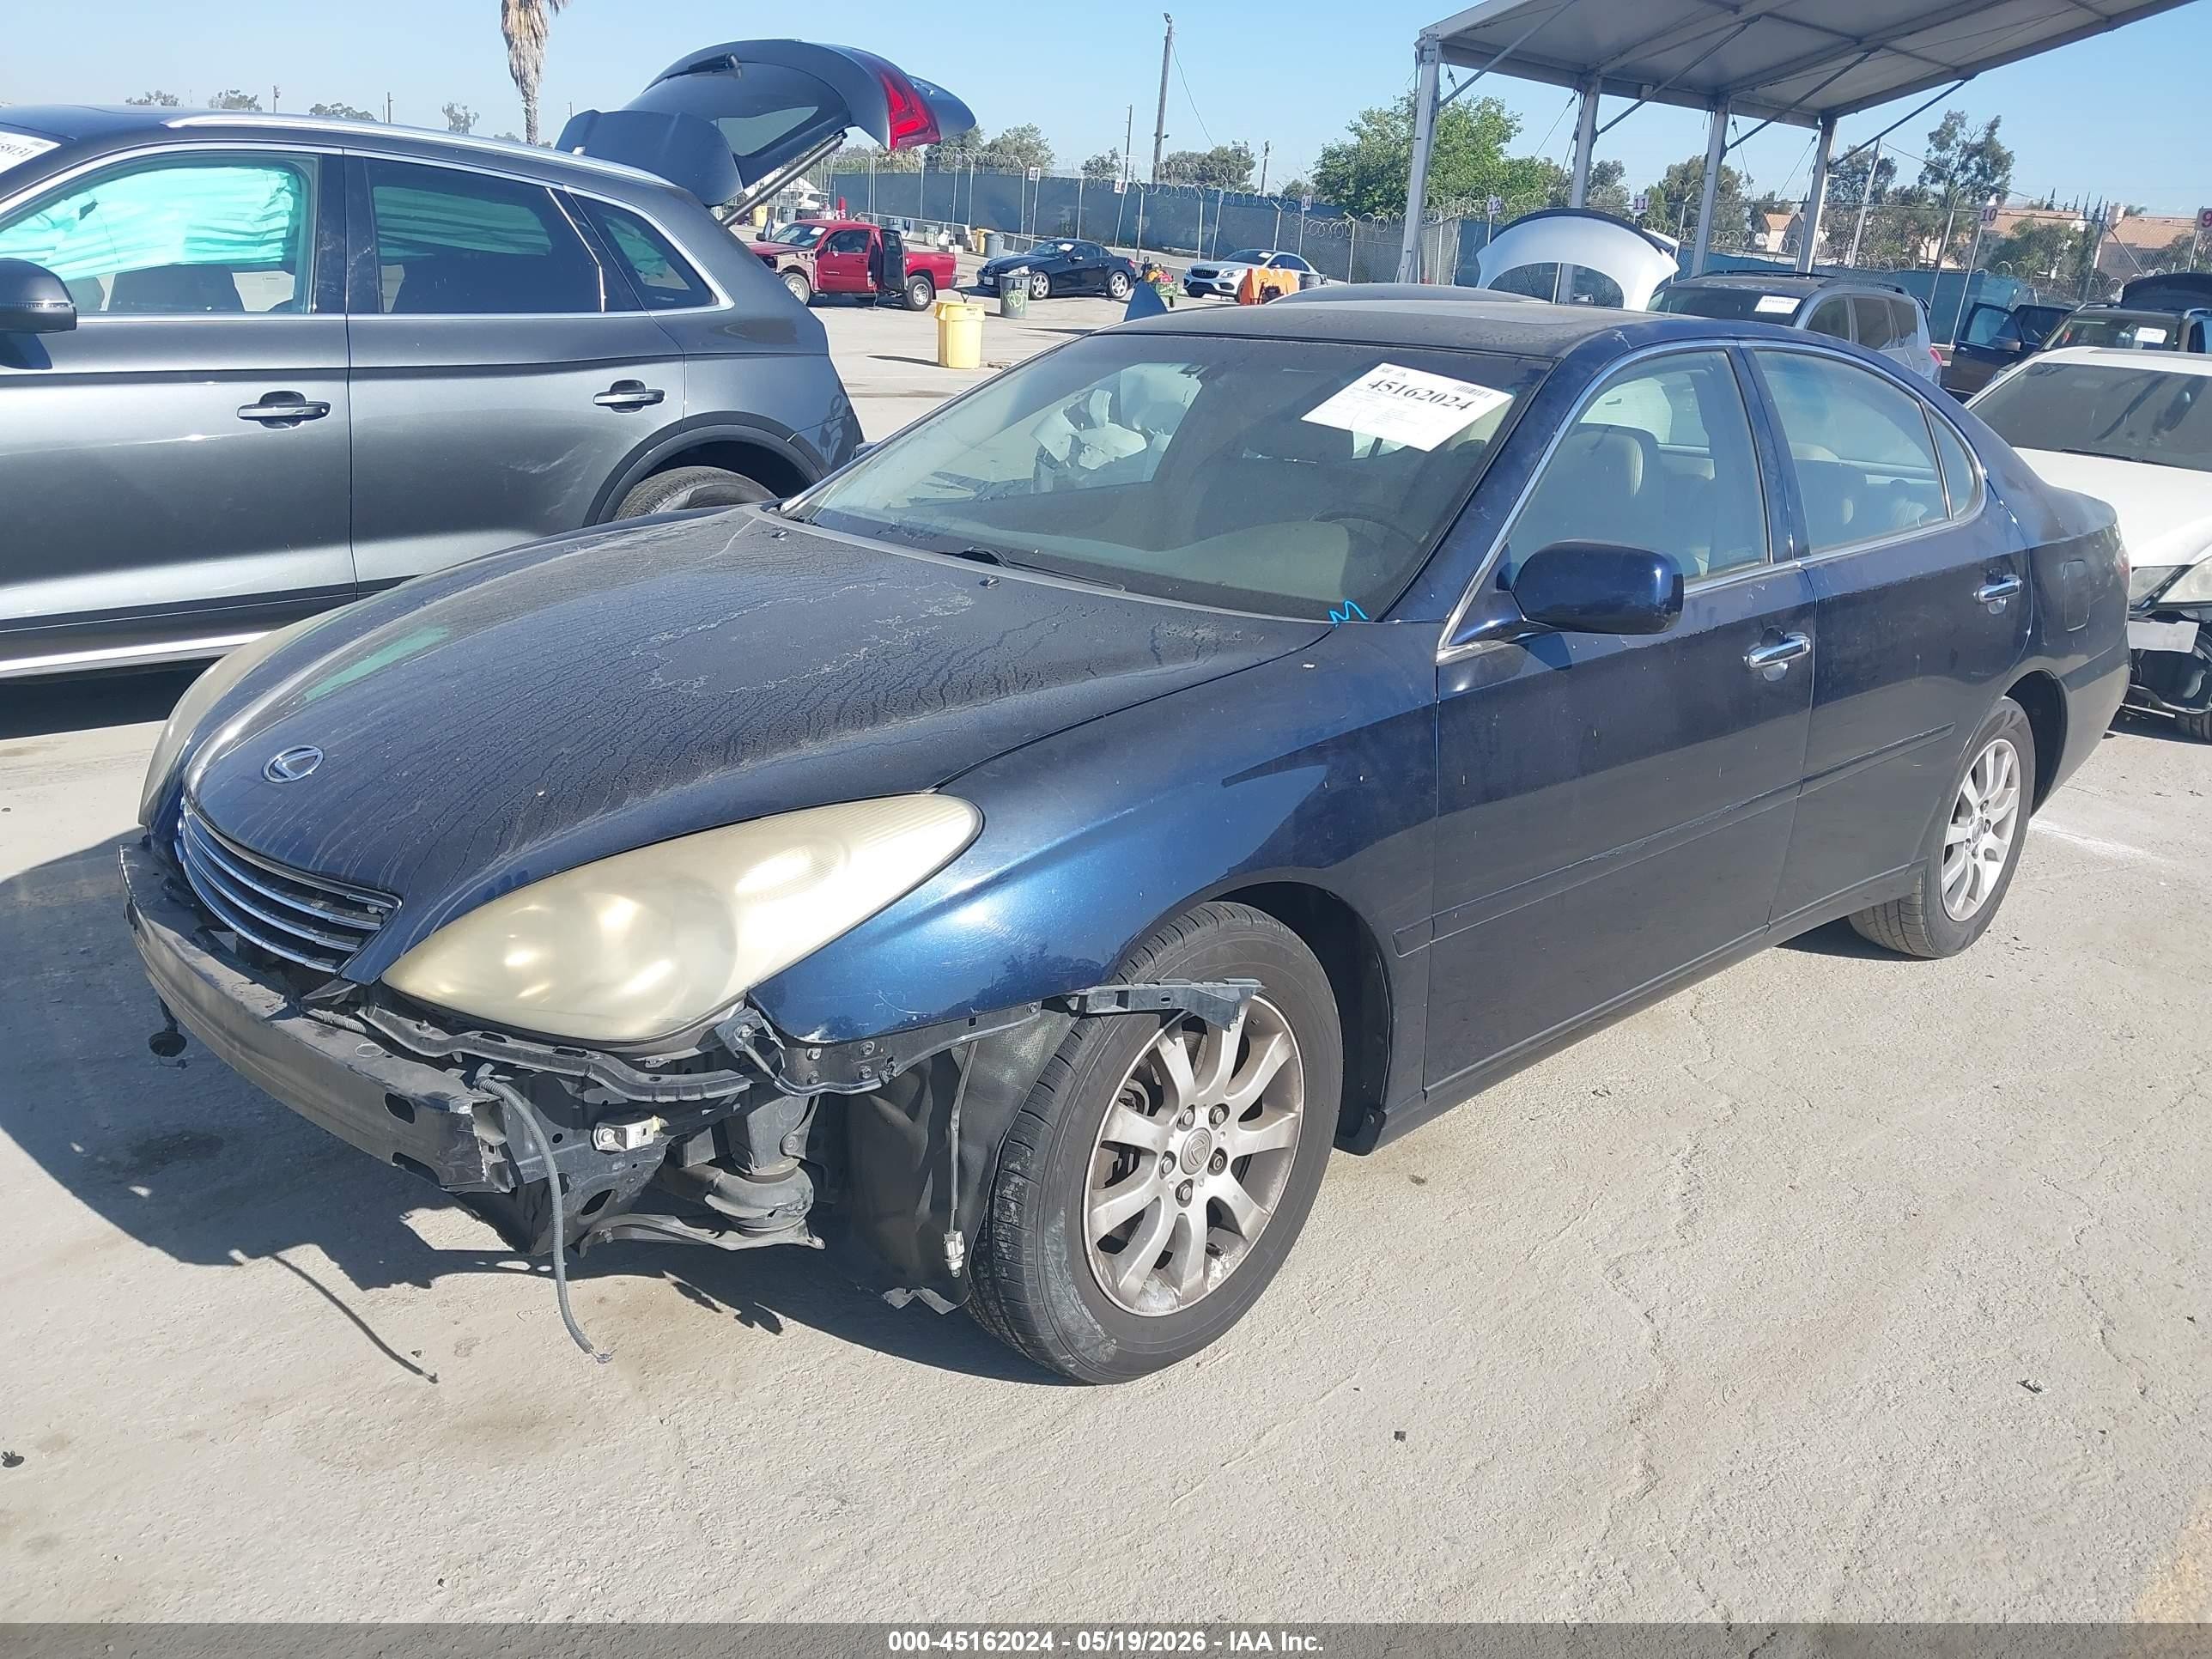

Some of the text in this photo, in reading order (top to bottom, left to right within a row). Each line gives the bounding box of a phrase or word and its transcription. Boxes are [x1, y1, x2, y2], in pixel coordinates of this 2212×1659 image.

[1488, 200, 1501, 212] 12
[1633, 198, 1647, 210] 11
[1980, 208, 1997, 222] 10
[2201, 210, 2212, 228] 9
[1367, 379, 1475, 410] 45162024
